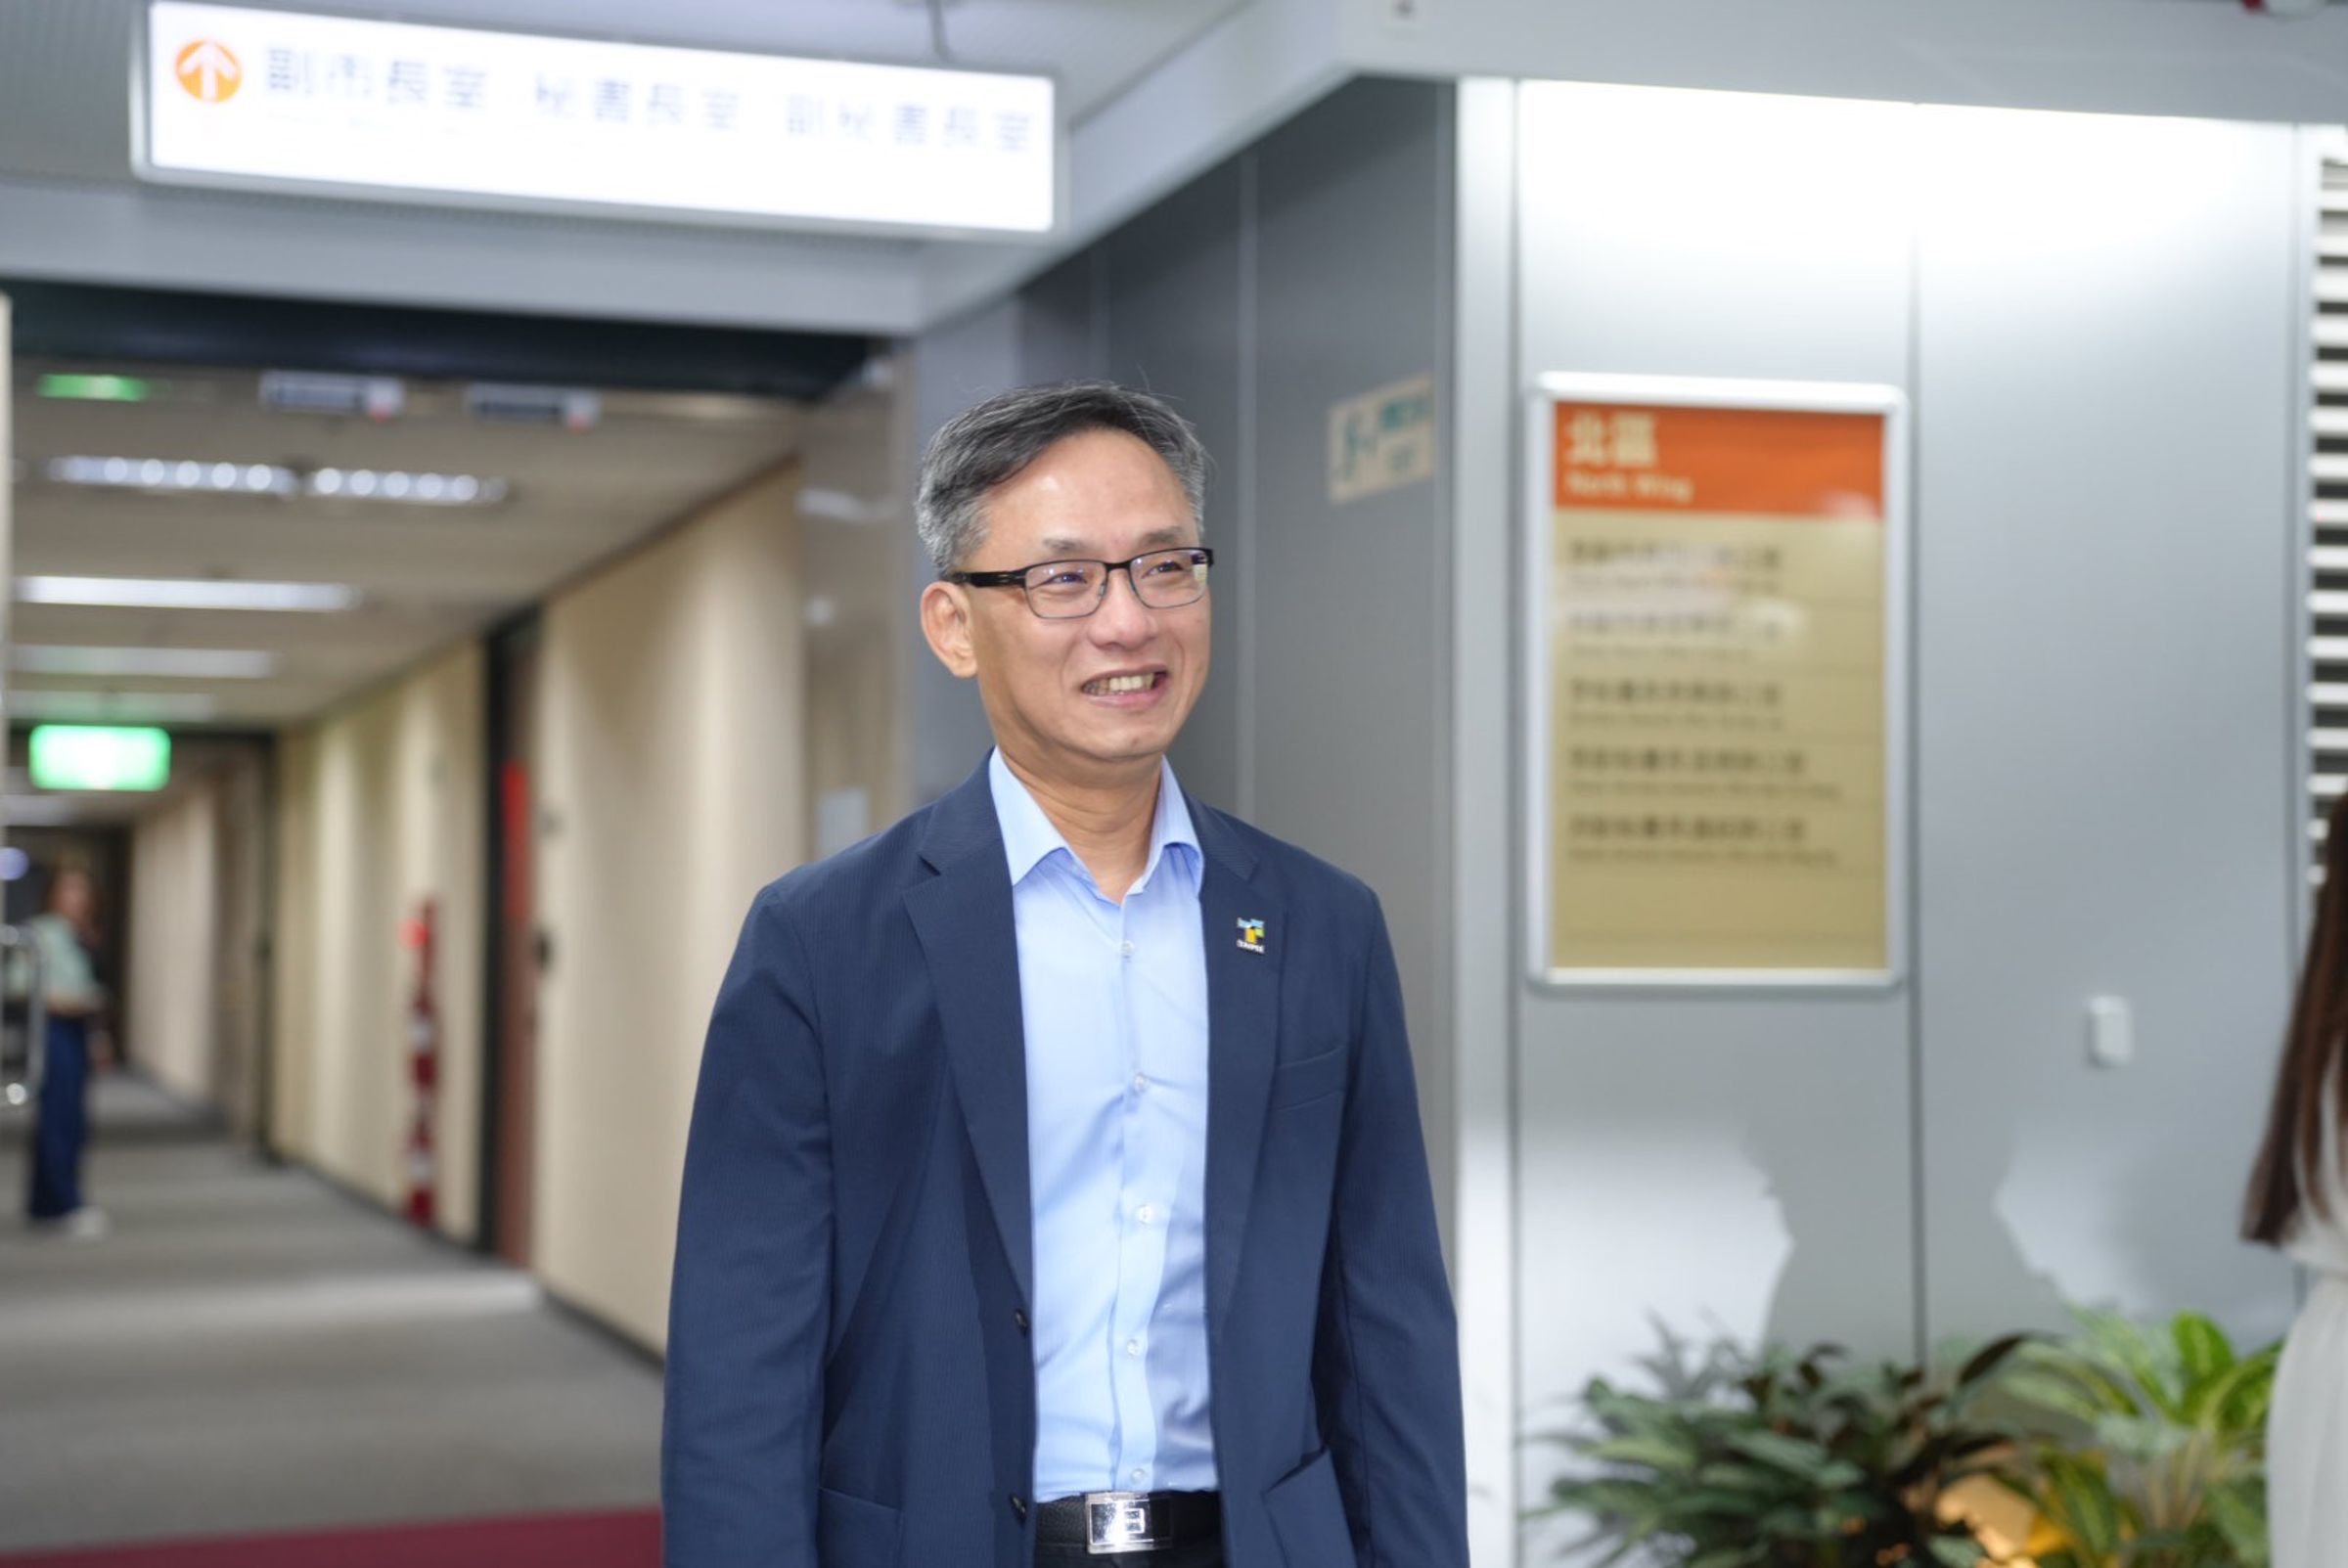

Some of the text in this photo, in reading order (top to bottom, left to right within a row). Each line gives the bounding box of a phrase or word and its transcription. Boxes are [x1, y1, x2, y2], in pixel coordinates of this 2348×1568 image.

[266, 46, 488, 111] 副市長室
[533, 72, 740, 132] 秘書長室
